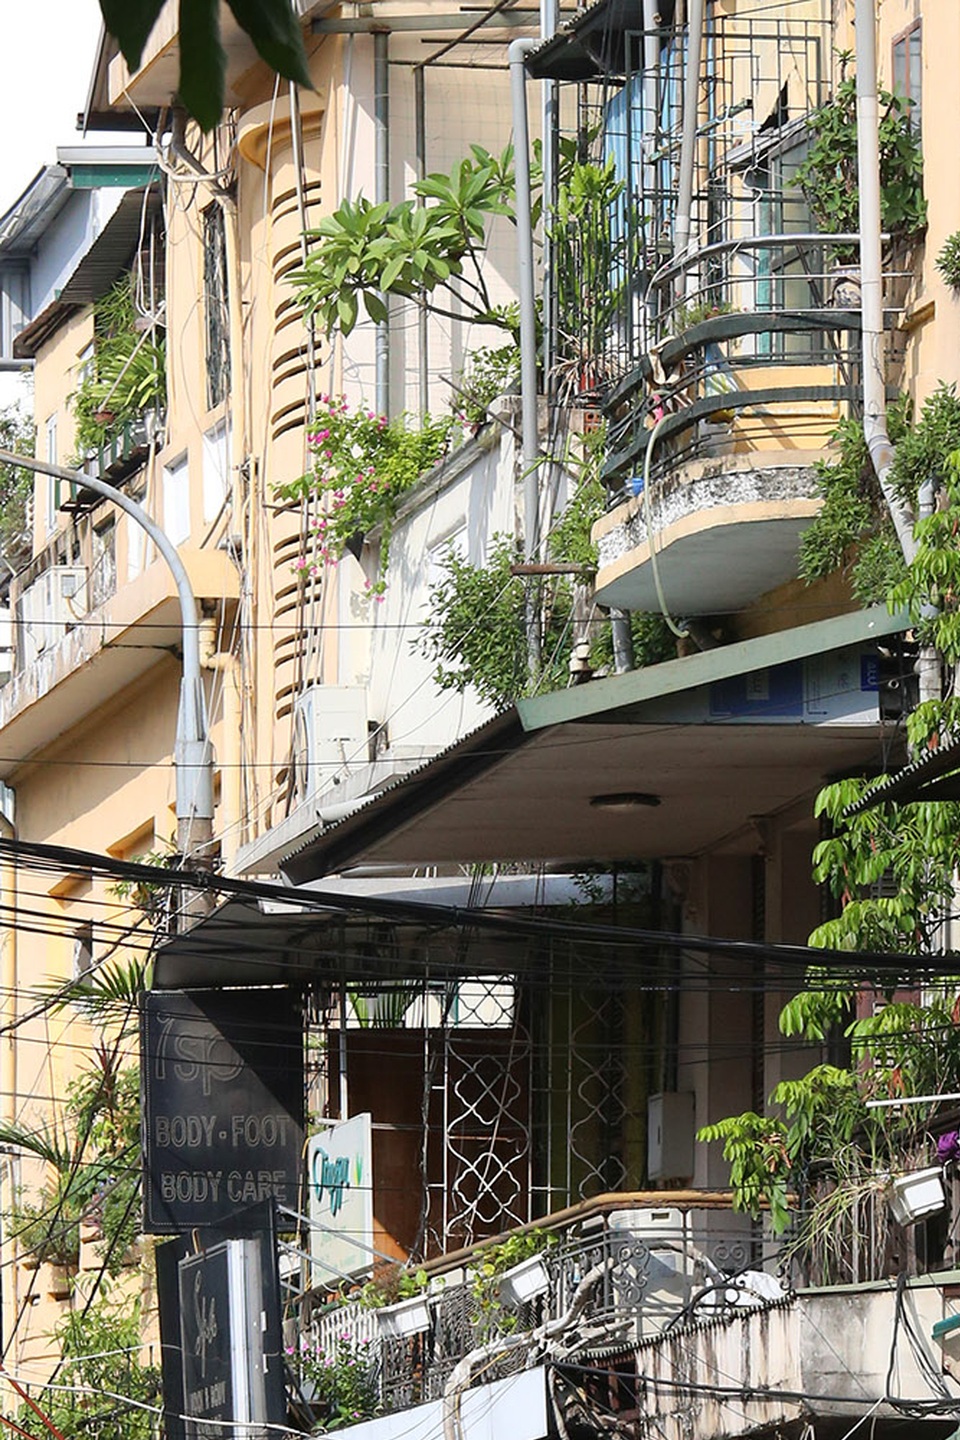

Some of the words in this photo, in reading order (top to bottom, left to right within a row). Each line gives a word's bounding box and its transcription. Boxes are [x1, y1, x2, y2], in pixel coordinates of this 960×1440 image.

[155, 1115, 217, 1148] BODY
[232, 1115, 290, 1148] FOOT
[161, 1171, 222, 1203] BODY
[228, 1169, 288, 1202] CARE
